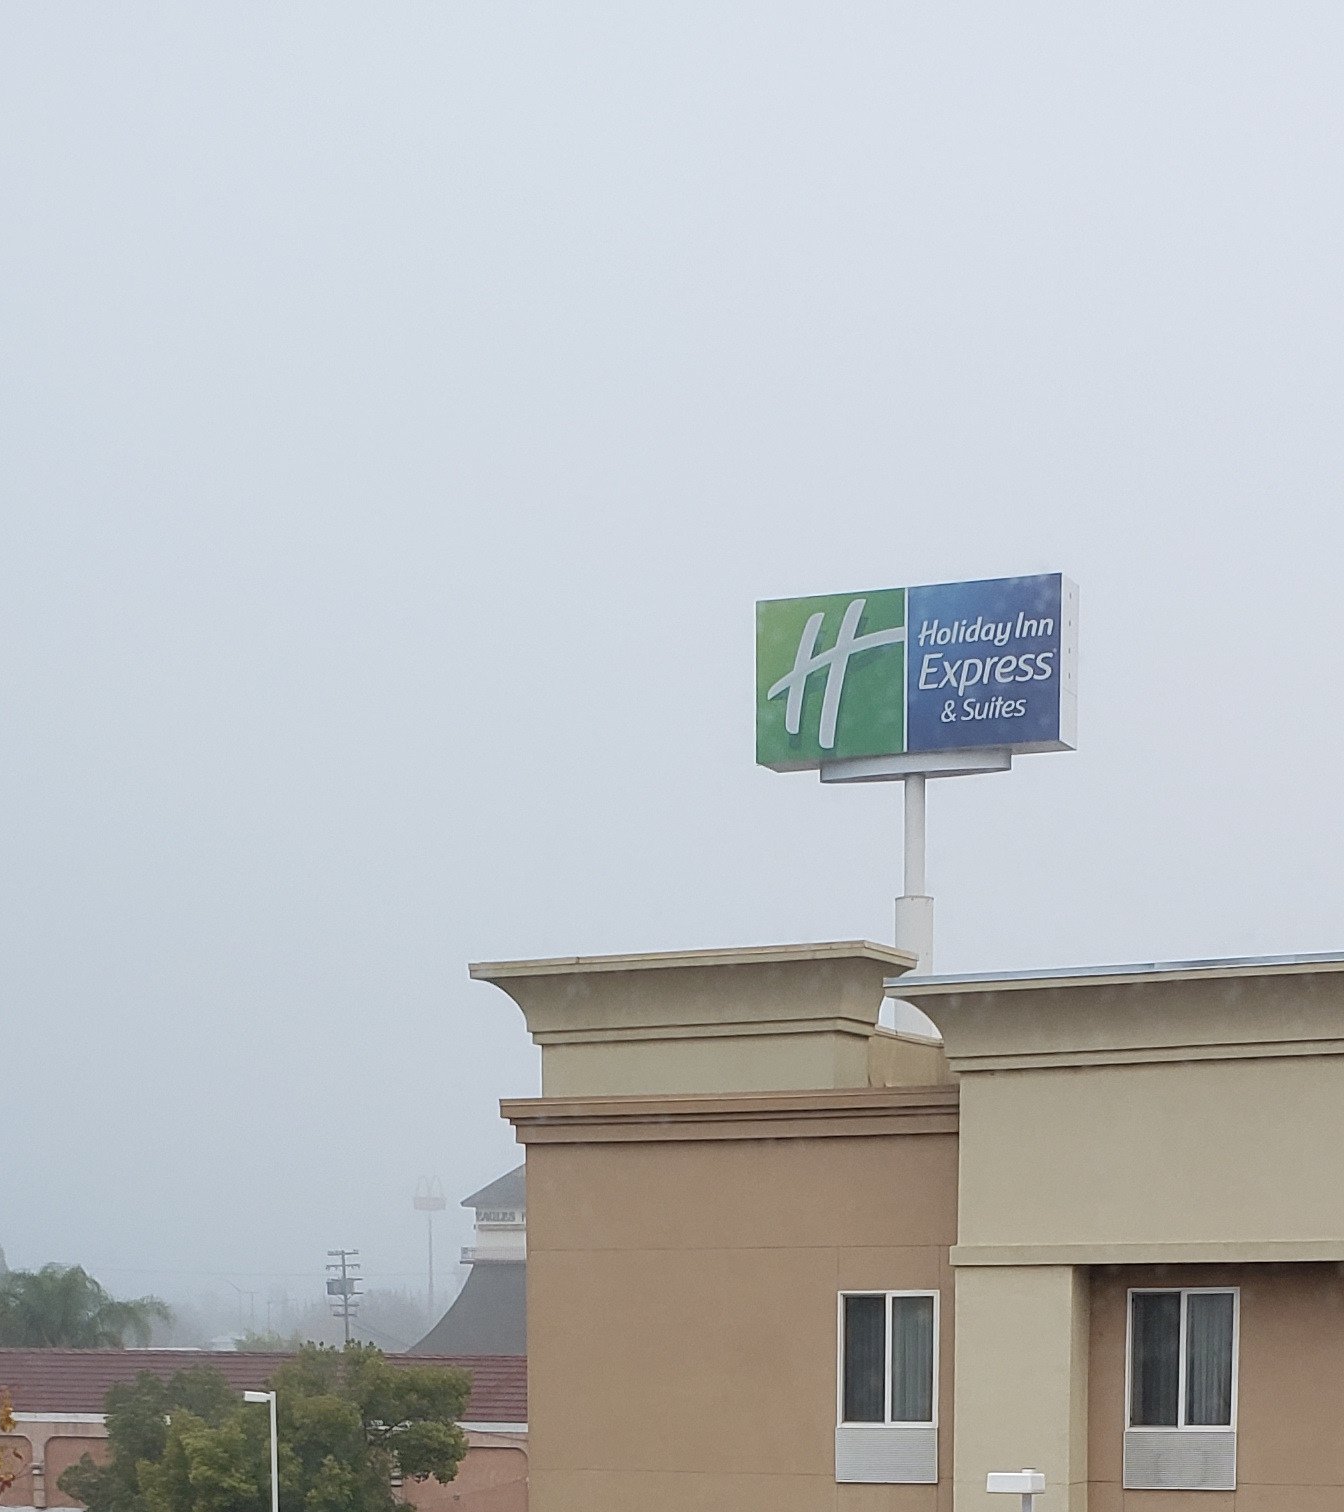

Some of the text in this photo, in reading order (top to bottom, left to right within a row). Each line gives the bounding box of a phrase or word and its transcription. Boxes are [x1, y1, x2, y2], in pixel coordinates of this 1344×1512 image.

[918, 611, 1054, 647] Holiday Inn
[918, 652, 1054, 697] Express
[941, 696, 1027, 723] & Suites
